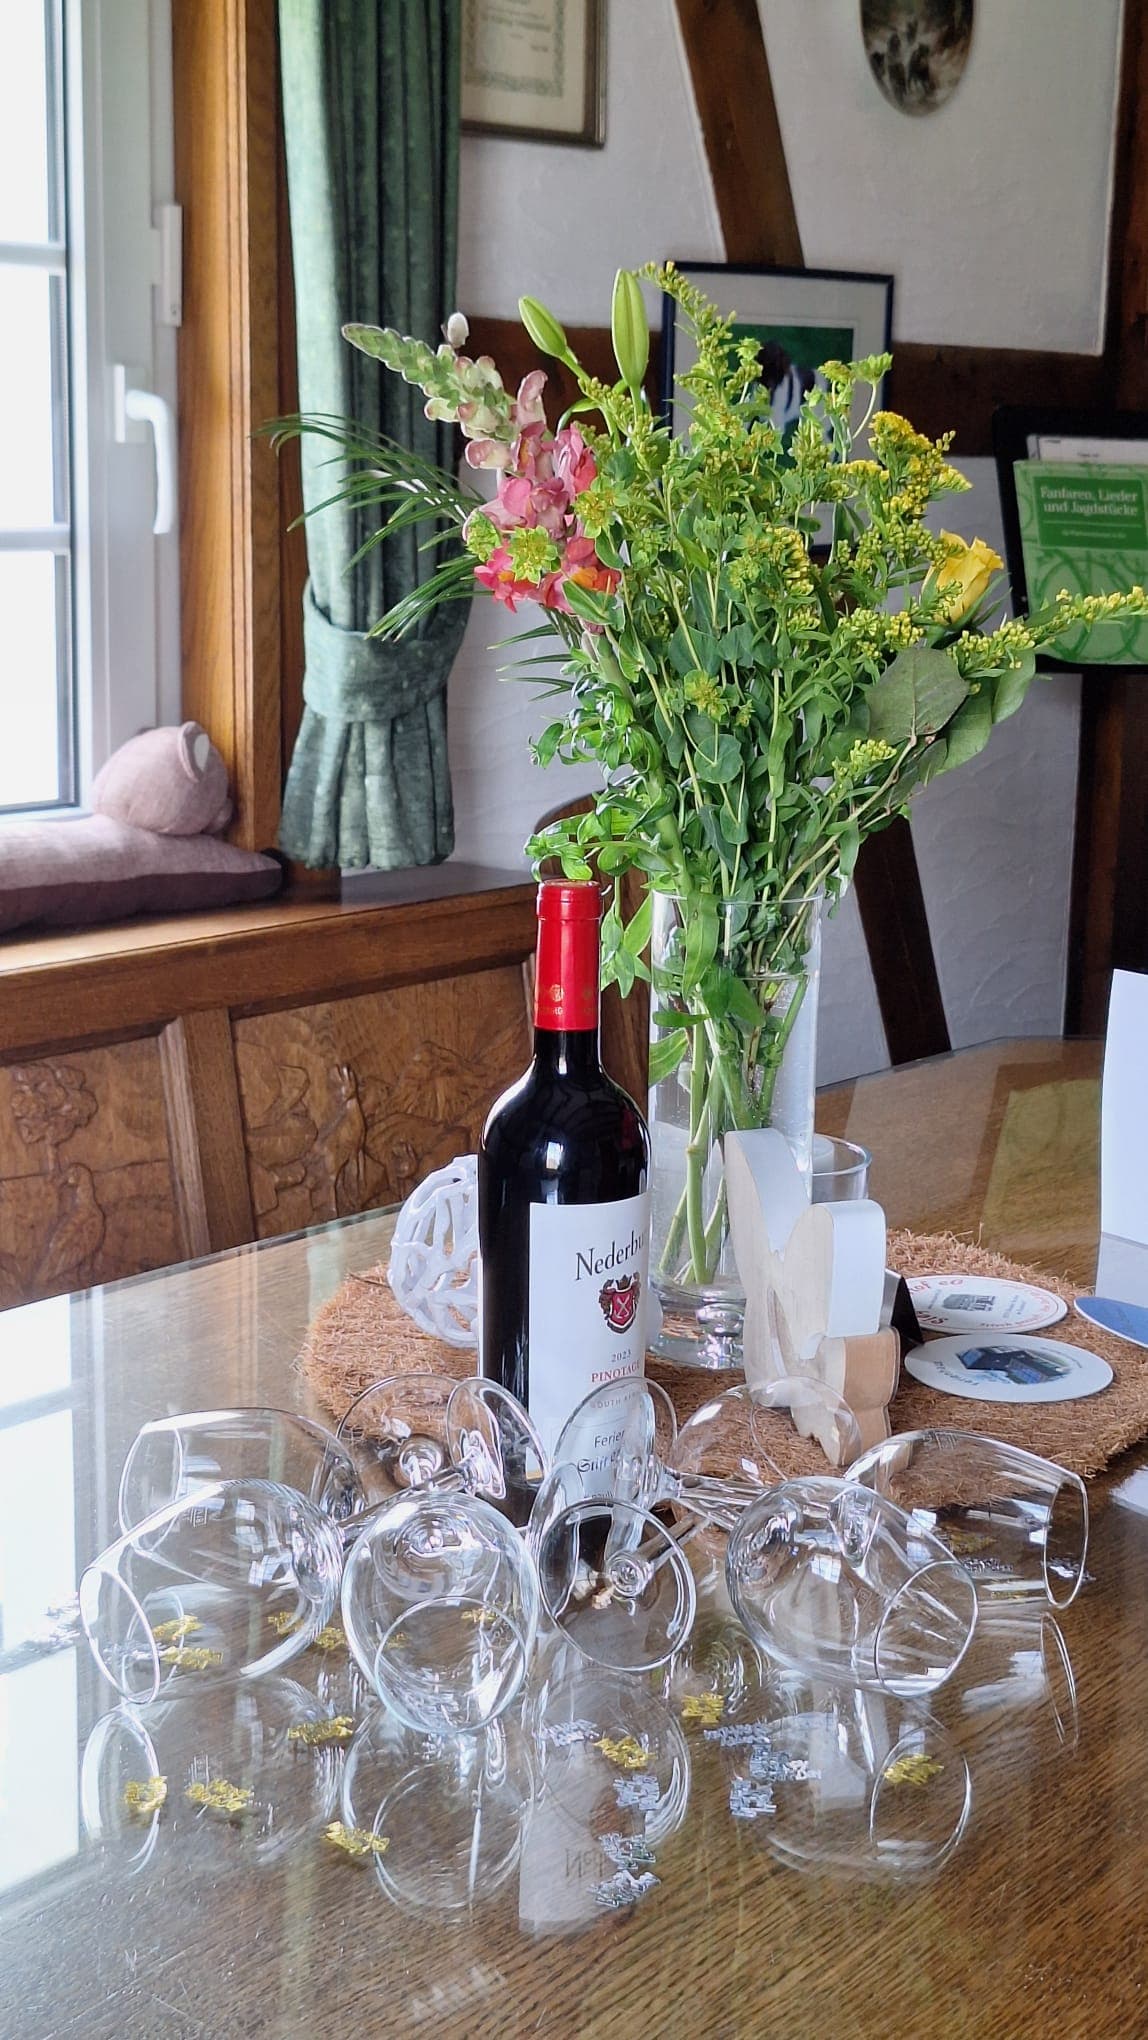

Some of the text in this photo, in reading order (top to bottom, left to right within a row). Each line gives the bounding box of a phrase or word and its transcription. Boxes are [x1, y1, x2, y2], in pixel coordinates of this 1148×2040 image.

[1098, 489, 1138, 502] Lieder
[1044, 501, 1137, 516] und Jagdstücke
